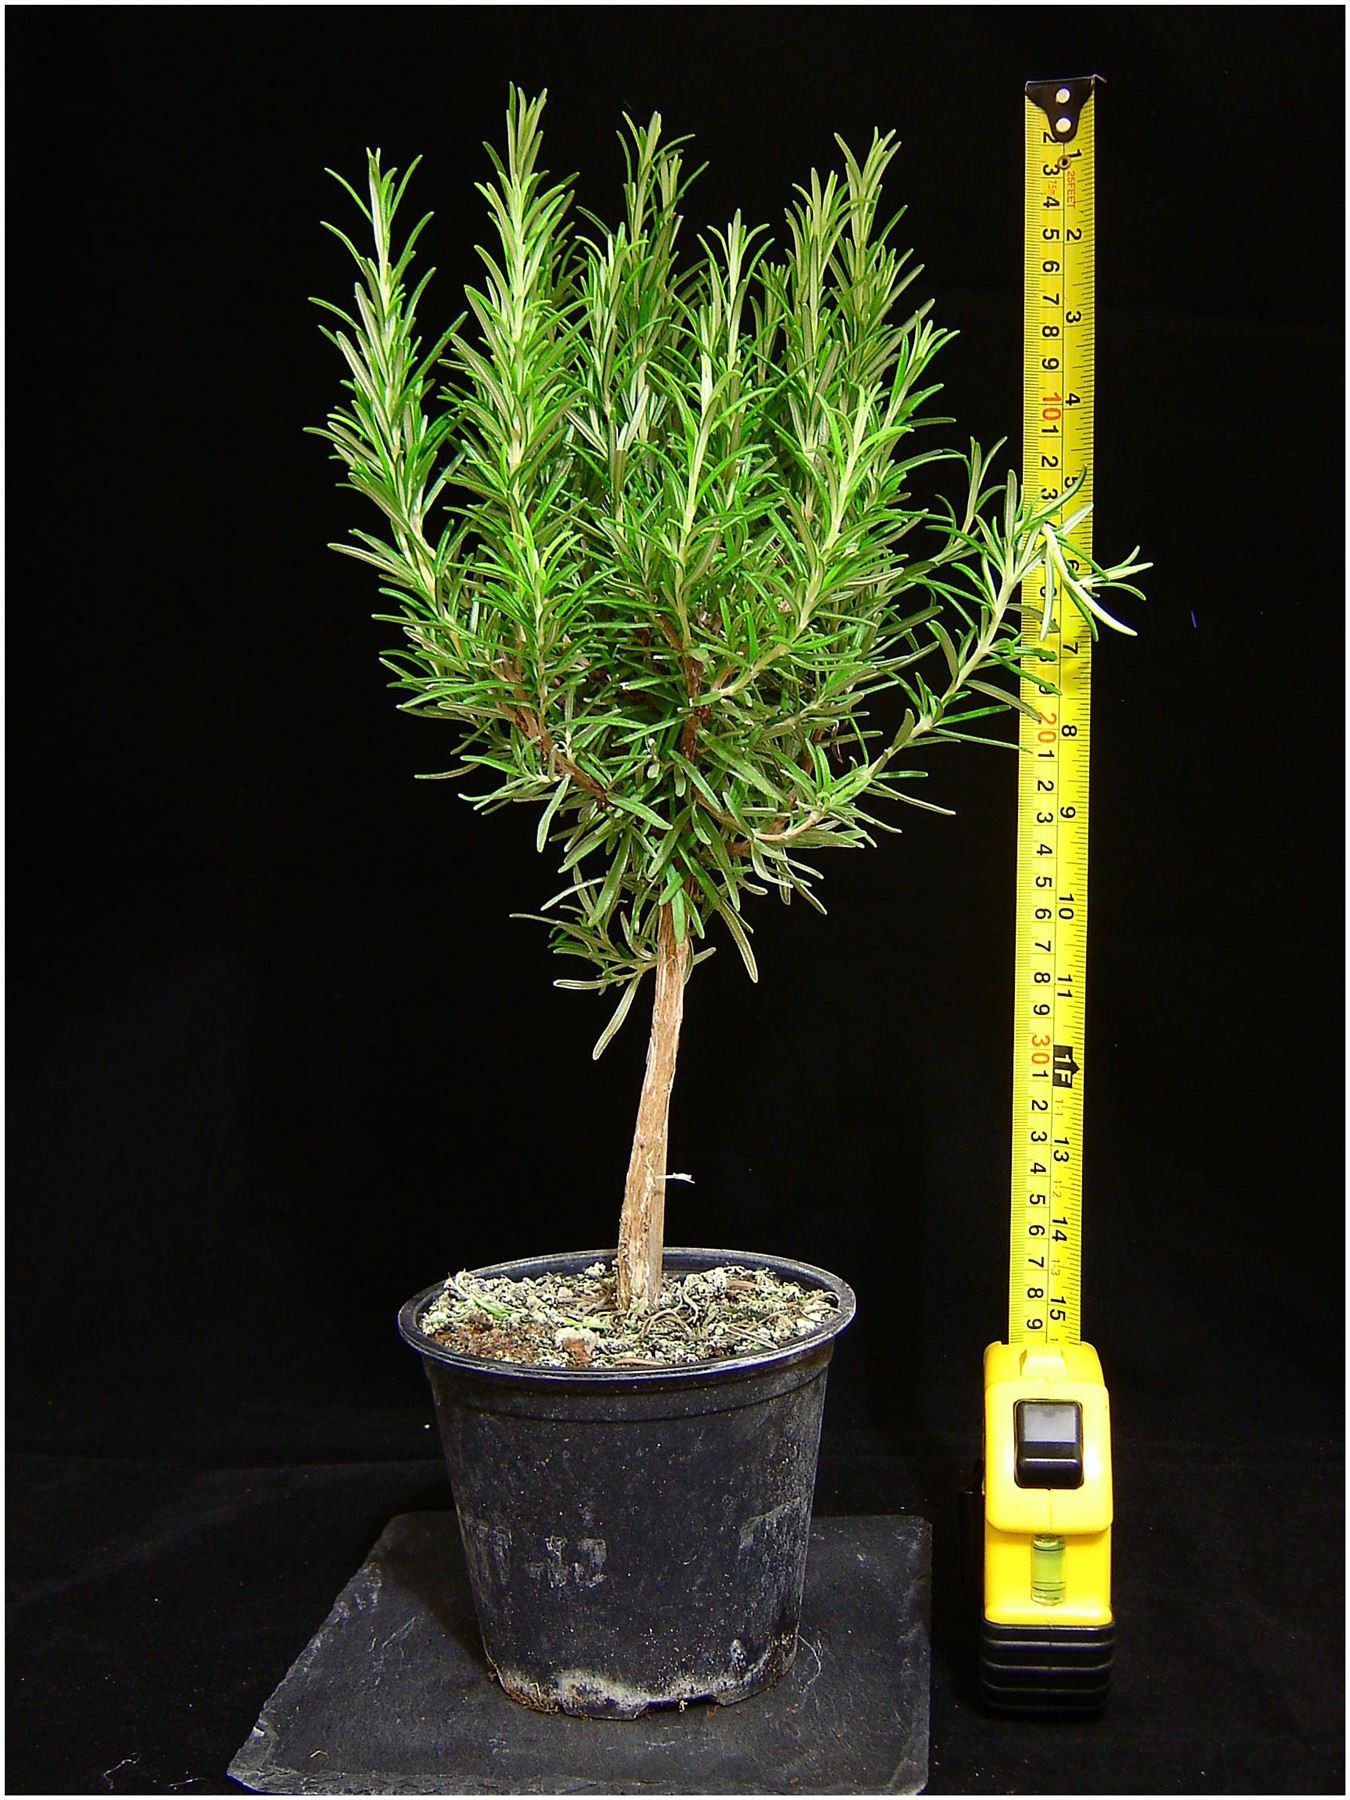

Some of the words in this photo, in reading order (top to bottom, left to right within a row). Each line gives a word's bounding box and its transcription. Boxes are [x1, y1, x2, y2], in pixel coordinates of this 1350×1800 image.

[1067, 149, 1082, 158] 1
[1043, 164, 1060, 176] 3
[1066, 170, 1076, 209] 25FEET
[1043, 196, 1060, 208] 4
[1043, 229, 1060, 240] 5
[1067, 228, 1082, 241] 2
[1042, 261, 1060, 273] 6
[1042, 293, 1059, 305] 7
[1066, 311, 1081, 323] 3
[1042, 326, 1059, 337] 8
[1042, 358, 1059, 370] 9
[1065, 393, 1080, 406] 4
[1042, 392, 1061, 420] 10
[1042, 425, 1059, 433] 1
[1041, 456, 1058, 467] 2
[1064, 476, 1078, 489] 5
[1041, 488, 1058, 500] 3
[1063, 642, 1078, 654] 7
[1038, 712, 1056, 743] 20
[1062, 725, 1077, 737] 8
[1038, 750, 1055, 758] 1
[1037, 780, 1054, 791] 2
[1037, 812, 1053, 823] 3
[1060, 806, 1076, 819] 9
[1037, 844, 1052, 855] 4
[1036, 876, 1052, 887] 5
[1059, 894, 1074, 919] 10
[1035, 908, 1051, 919] 6
[1035, 941, 1051, 952] 7
[1034, 972, 1050, 983] 8
[1057, 974, 1073, 998] 11
[1034, 1004, 1050, 1015] 9
[1032, 1035, 1050, 1064] 30
[1032, 1070, 1049, 1078] 1
[1054, 1054, 1071, 1084] 1F
[1032, 1100, 1048, 1111] 2
[1031, 1131, 1047, 1142] 3
[1054, 1137, 1069, 1162] 13
[1030, 1163, 1046, 1174] 4
[1029, 1194, 1046, 1205] 5
[1029, 1225, 1045, 1236] 6
[1052, 1217, 1068, 1241] 14
[1028, 1257, 1044, 1268] 7
[1027, 1288, 1044, 1298] 8
[1050, 1296, 1066, 1321] 15
[1027, 1319, 1043, 1330] 9
